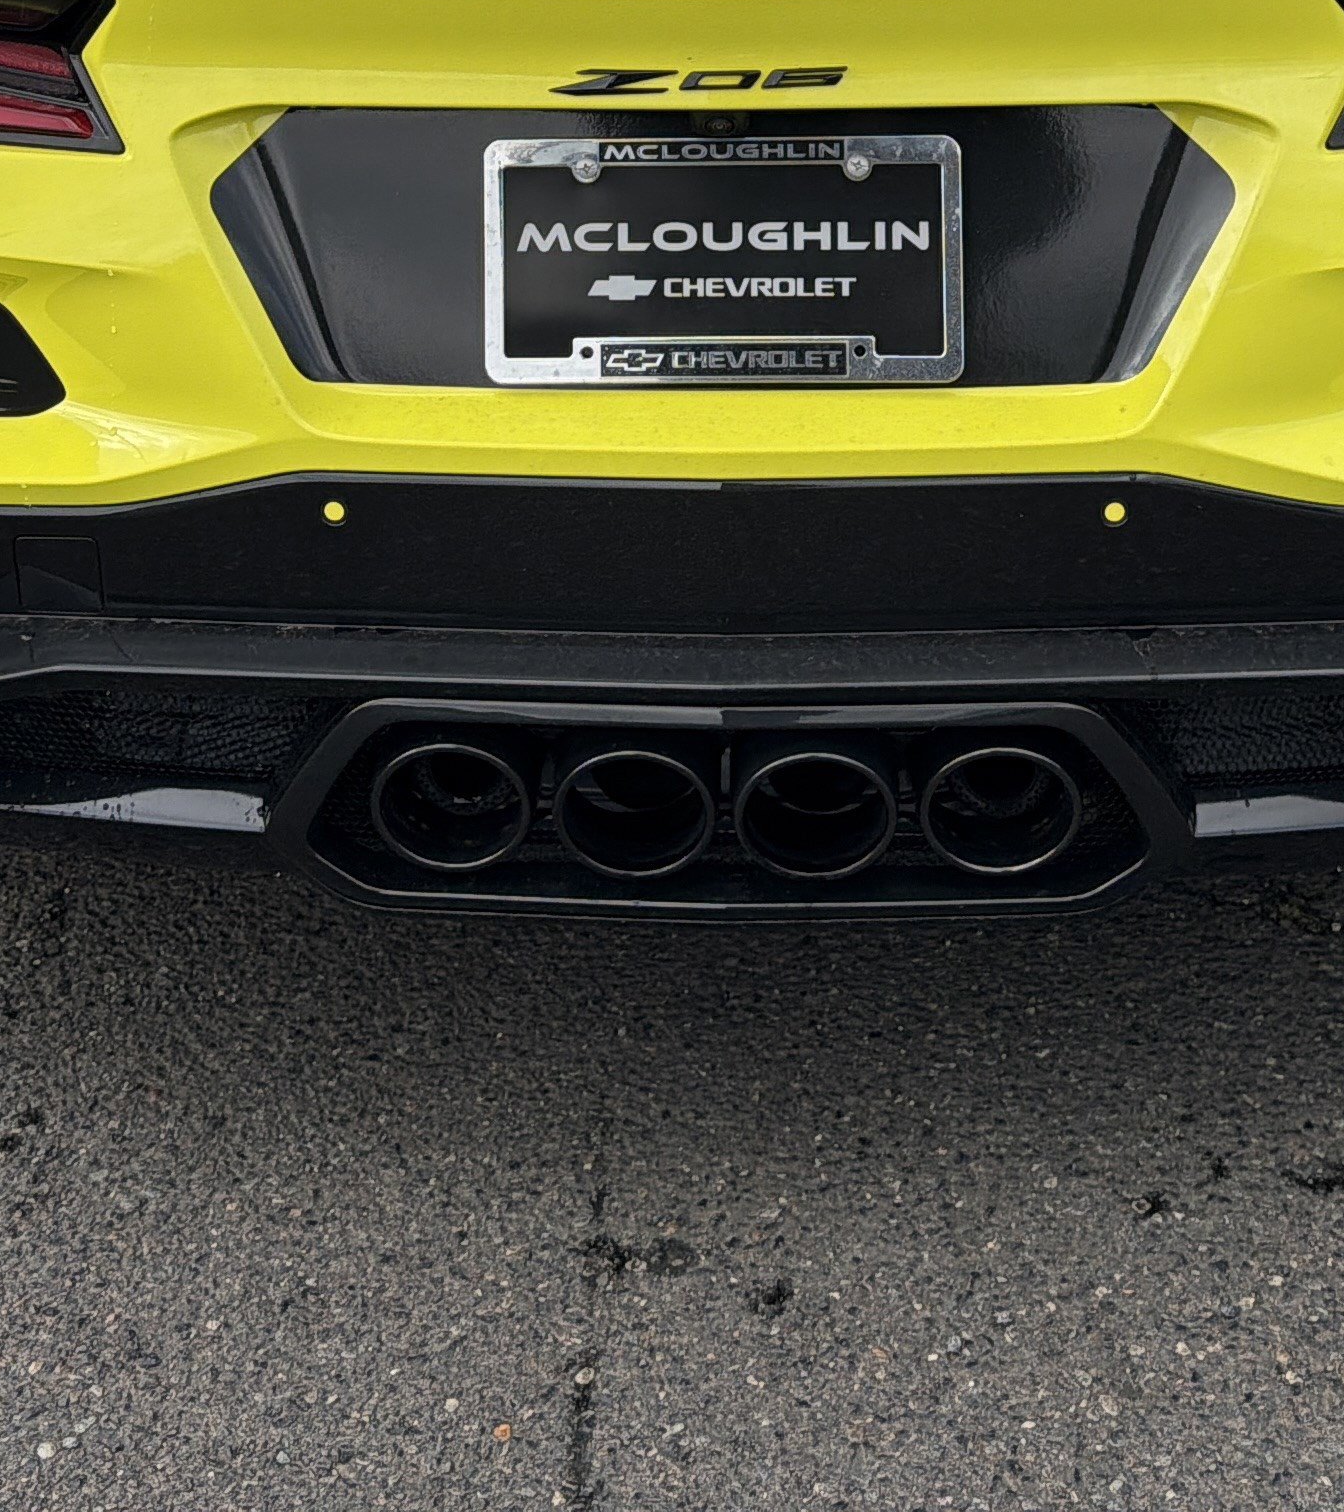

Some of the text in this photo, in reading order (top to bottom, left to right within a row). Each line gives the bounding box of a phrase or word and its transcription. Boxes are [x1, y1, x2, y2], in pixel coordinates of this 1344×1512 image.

[549, 65, 848, 96] Z06
[603, 142, 841, 161] MCLOUGHLIN
[516, 221, 930, 253] MCLOUGHLIN
[663, 277, 857, 298] CHEVROLET
[671, 349, 843, 370] CHEVROLET
